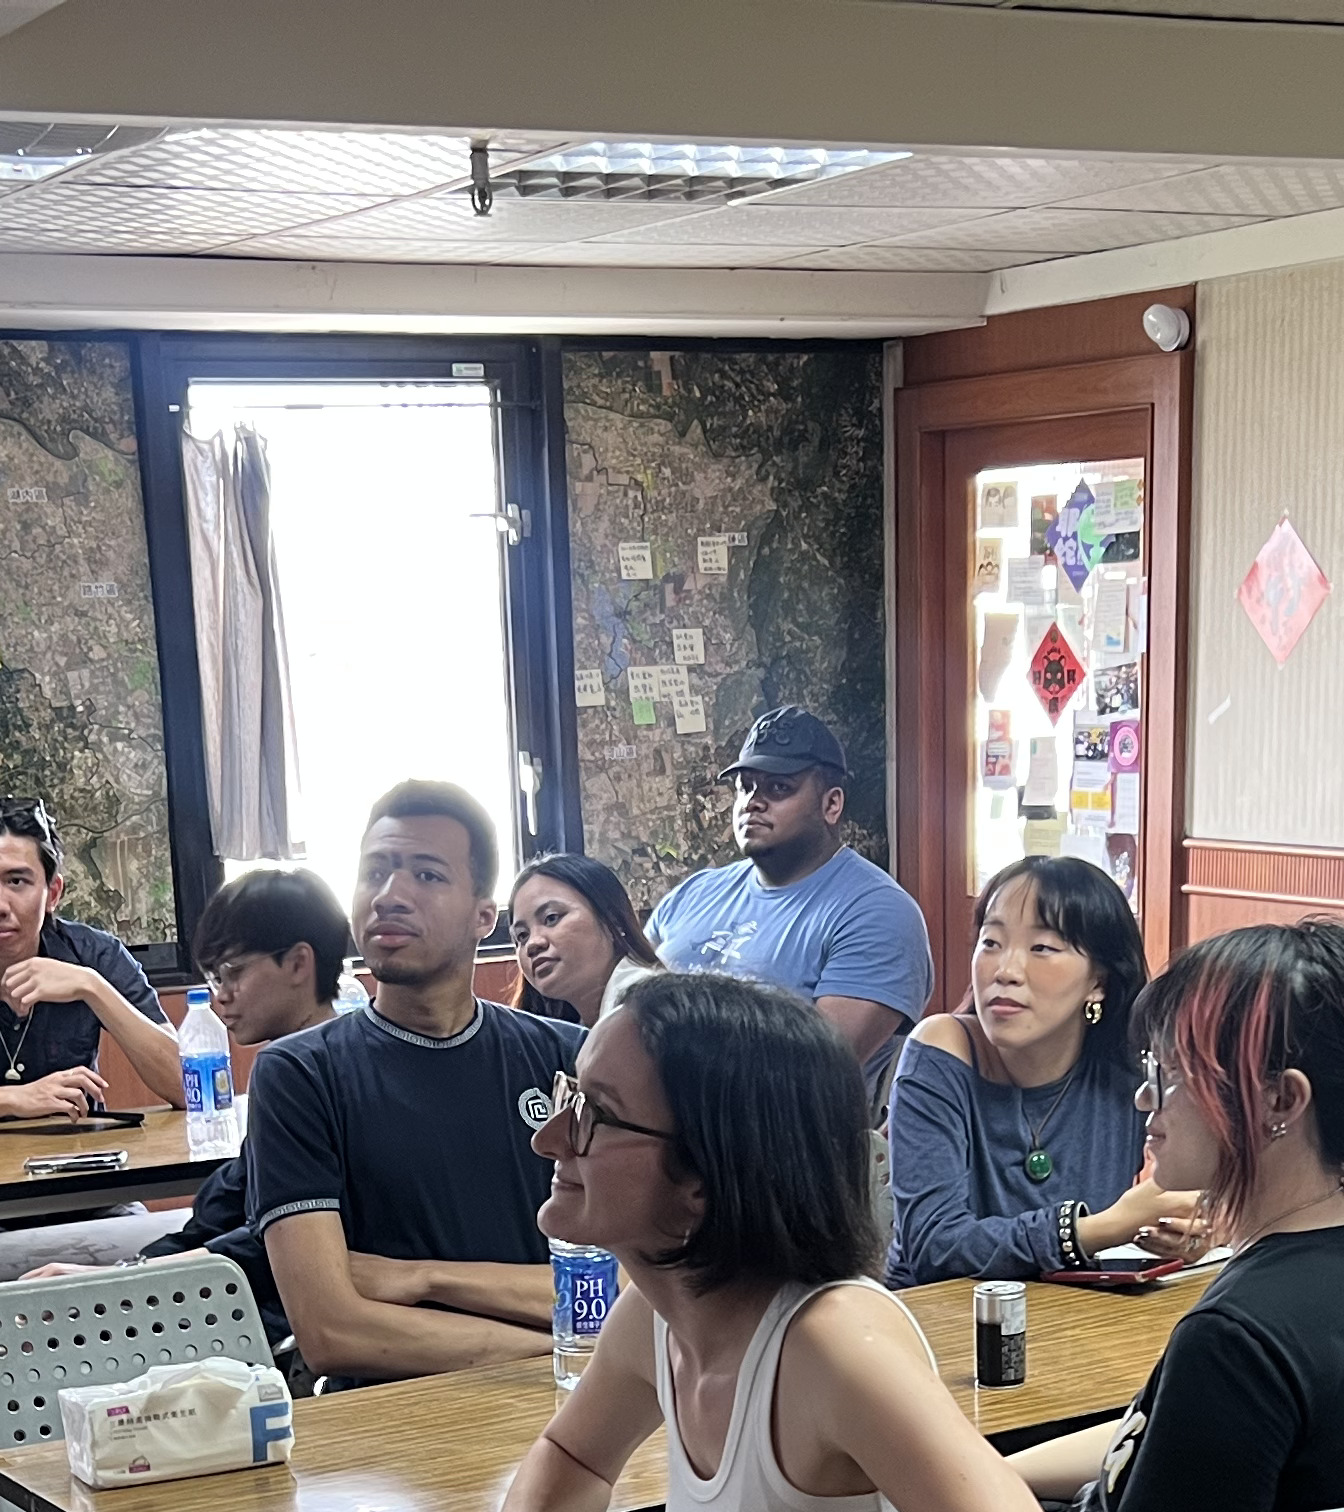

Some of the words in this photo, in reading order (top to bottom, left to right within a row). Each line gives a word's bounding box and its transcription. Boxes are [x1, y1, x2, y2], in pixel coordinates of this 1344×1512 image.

[575, 1278, 604, 1298] PH
[574, 1298, 607, 1320] 9.0
[250, 1401, 292, 1463] F
